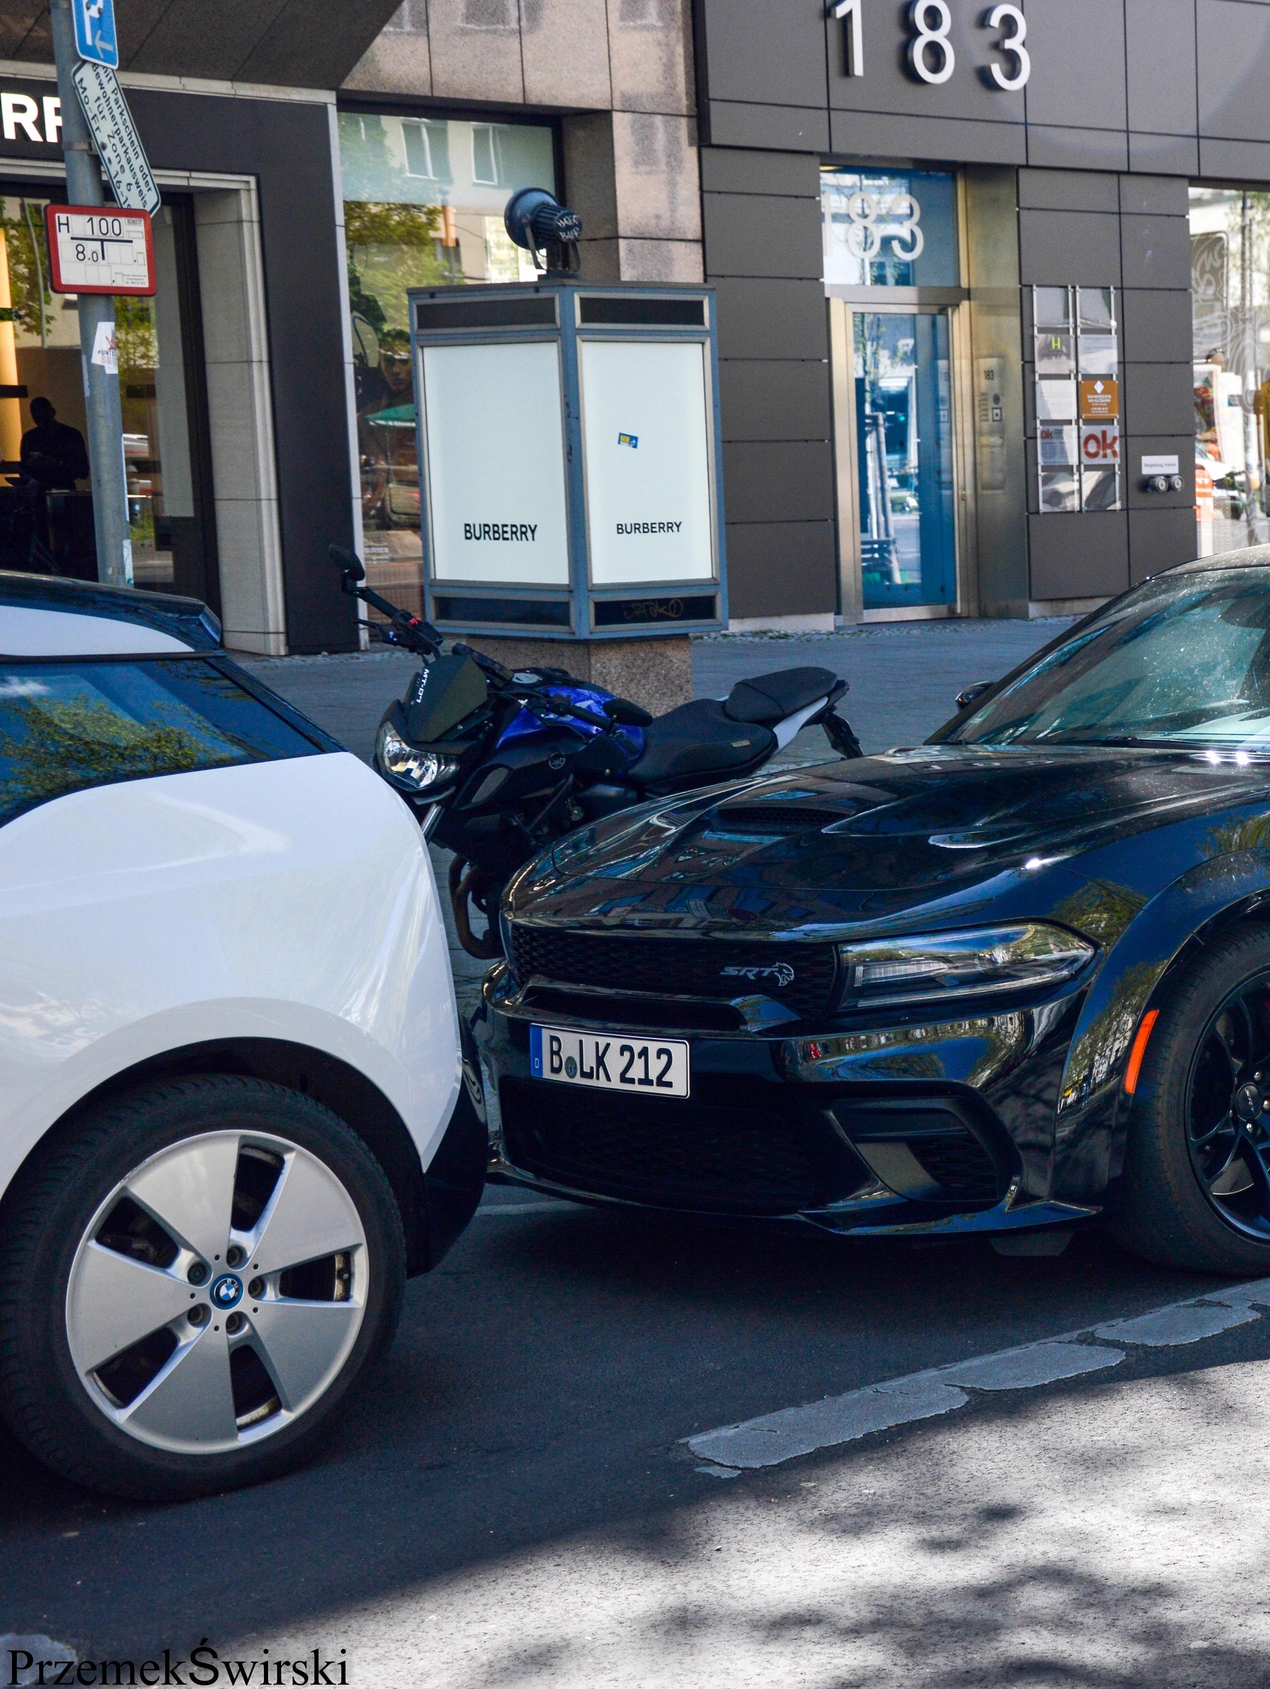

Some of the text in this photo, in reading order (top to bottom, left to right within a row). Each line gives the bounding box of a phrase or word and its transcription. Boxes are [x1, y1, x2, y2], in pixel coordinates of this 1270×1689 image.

[835, 0, 1031, 91] 183
[78, 78, 101, 133] Mo-Fr
[92, 64, 148, 208] Bewohnerparkausweis
[94, 96, 133, 192] für Zone 6
[112, 88, 140, 160] Parkschein
[139, 165, 153, 193] oder
[57, 215, 121, 236] H 100
[821, 191, 924, 260] 183
[463, 522, 538, 542] BURBERRY
[616, 521, 682, 535] BURBERRY
[416, 668, 430, 704] MT-07
[720, 966, 779, 980] SRT
[549, 1034, 674, 1089] B LK 212
